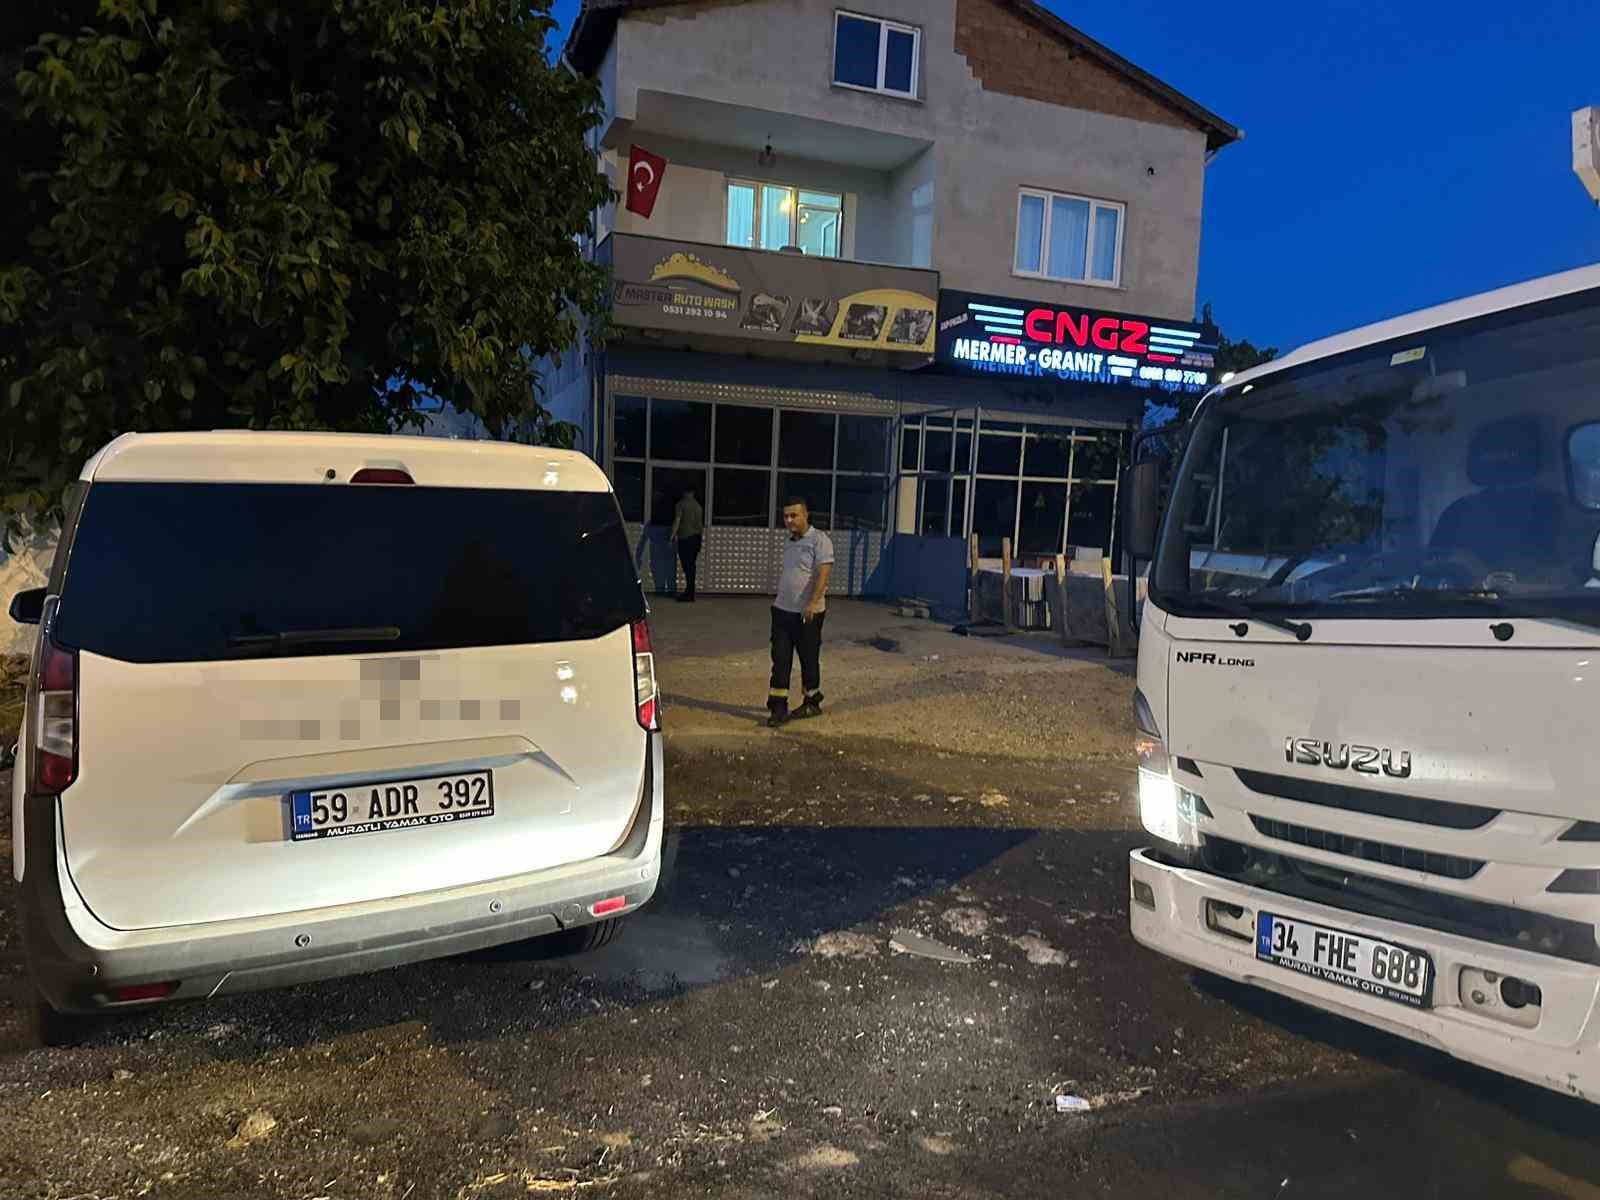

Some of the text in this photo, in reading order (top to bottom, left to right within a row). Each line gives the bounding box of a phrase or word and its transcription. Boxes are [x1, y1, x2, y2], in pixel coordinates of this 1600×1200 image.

[673, 292, 702, 306] AUTO
[1025, 308, 1149, 354] CNGZ
[953, 338, 1026, 366] MERMER
[1176, 651, 1255, 667] NPR LONG
[1284, 736, 1412, 779] ISUZU
[311, 777, 487, 825] 59 ADR 392
[296, 814, 310, 826] TR
[326, 823, 381, 837] MURATLI
[382, 818, 427, 830] YAMAK
[429, 814, 454, 823] OTO
[1262, 935, 1271, 947] TR
[1272, 921, 1421, 989] 34 FHE 688
[1279, 958, 1384, 995] MURATLI YAMAK OTO
